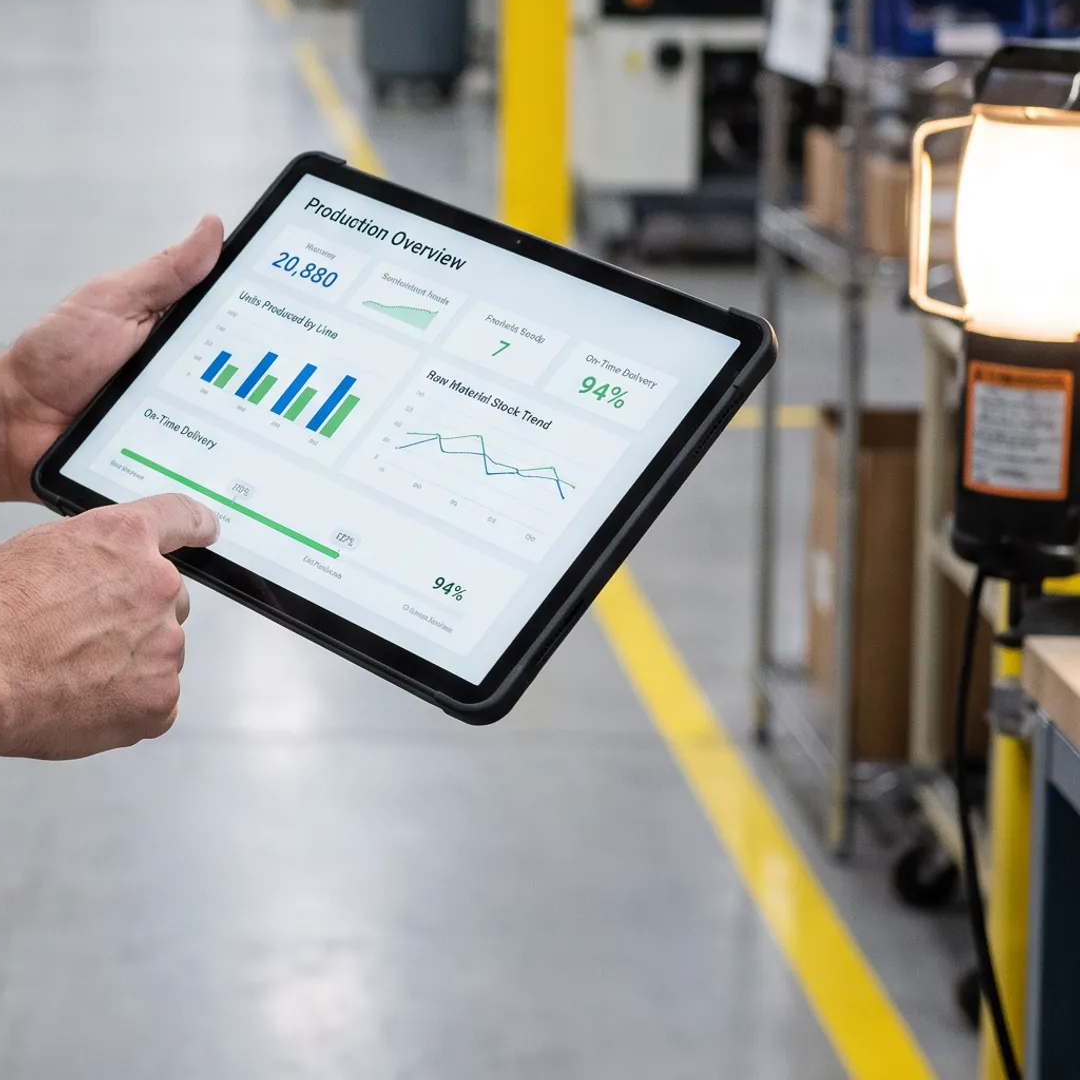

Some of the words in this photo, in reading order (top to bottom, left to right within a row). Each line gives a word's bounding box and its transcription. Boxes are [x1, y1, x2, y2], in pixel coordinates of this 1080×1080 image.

[304, 197, 389, 241] Production
[391, 231, 467, 270] Overview
[272, 252, 338, 288] 20,880
[239, 290, 261, 307] Units
[491, 340, 510, 357] 7
[585, 354, 621, 375] On-Time
[426, 370, 449, 387] Raw
[449, 379, 492, 405] Material
[491, 398, 521, 418] Stock
[521, 410, 552, 431] Trend
[578, 376, 628, 409] 94%
[432, 576, 467, 602] 94%
